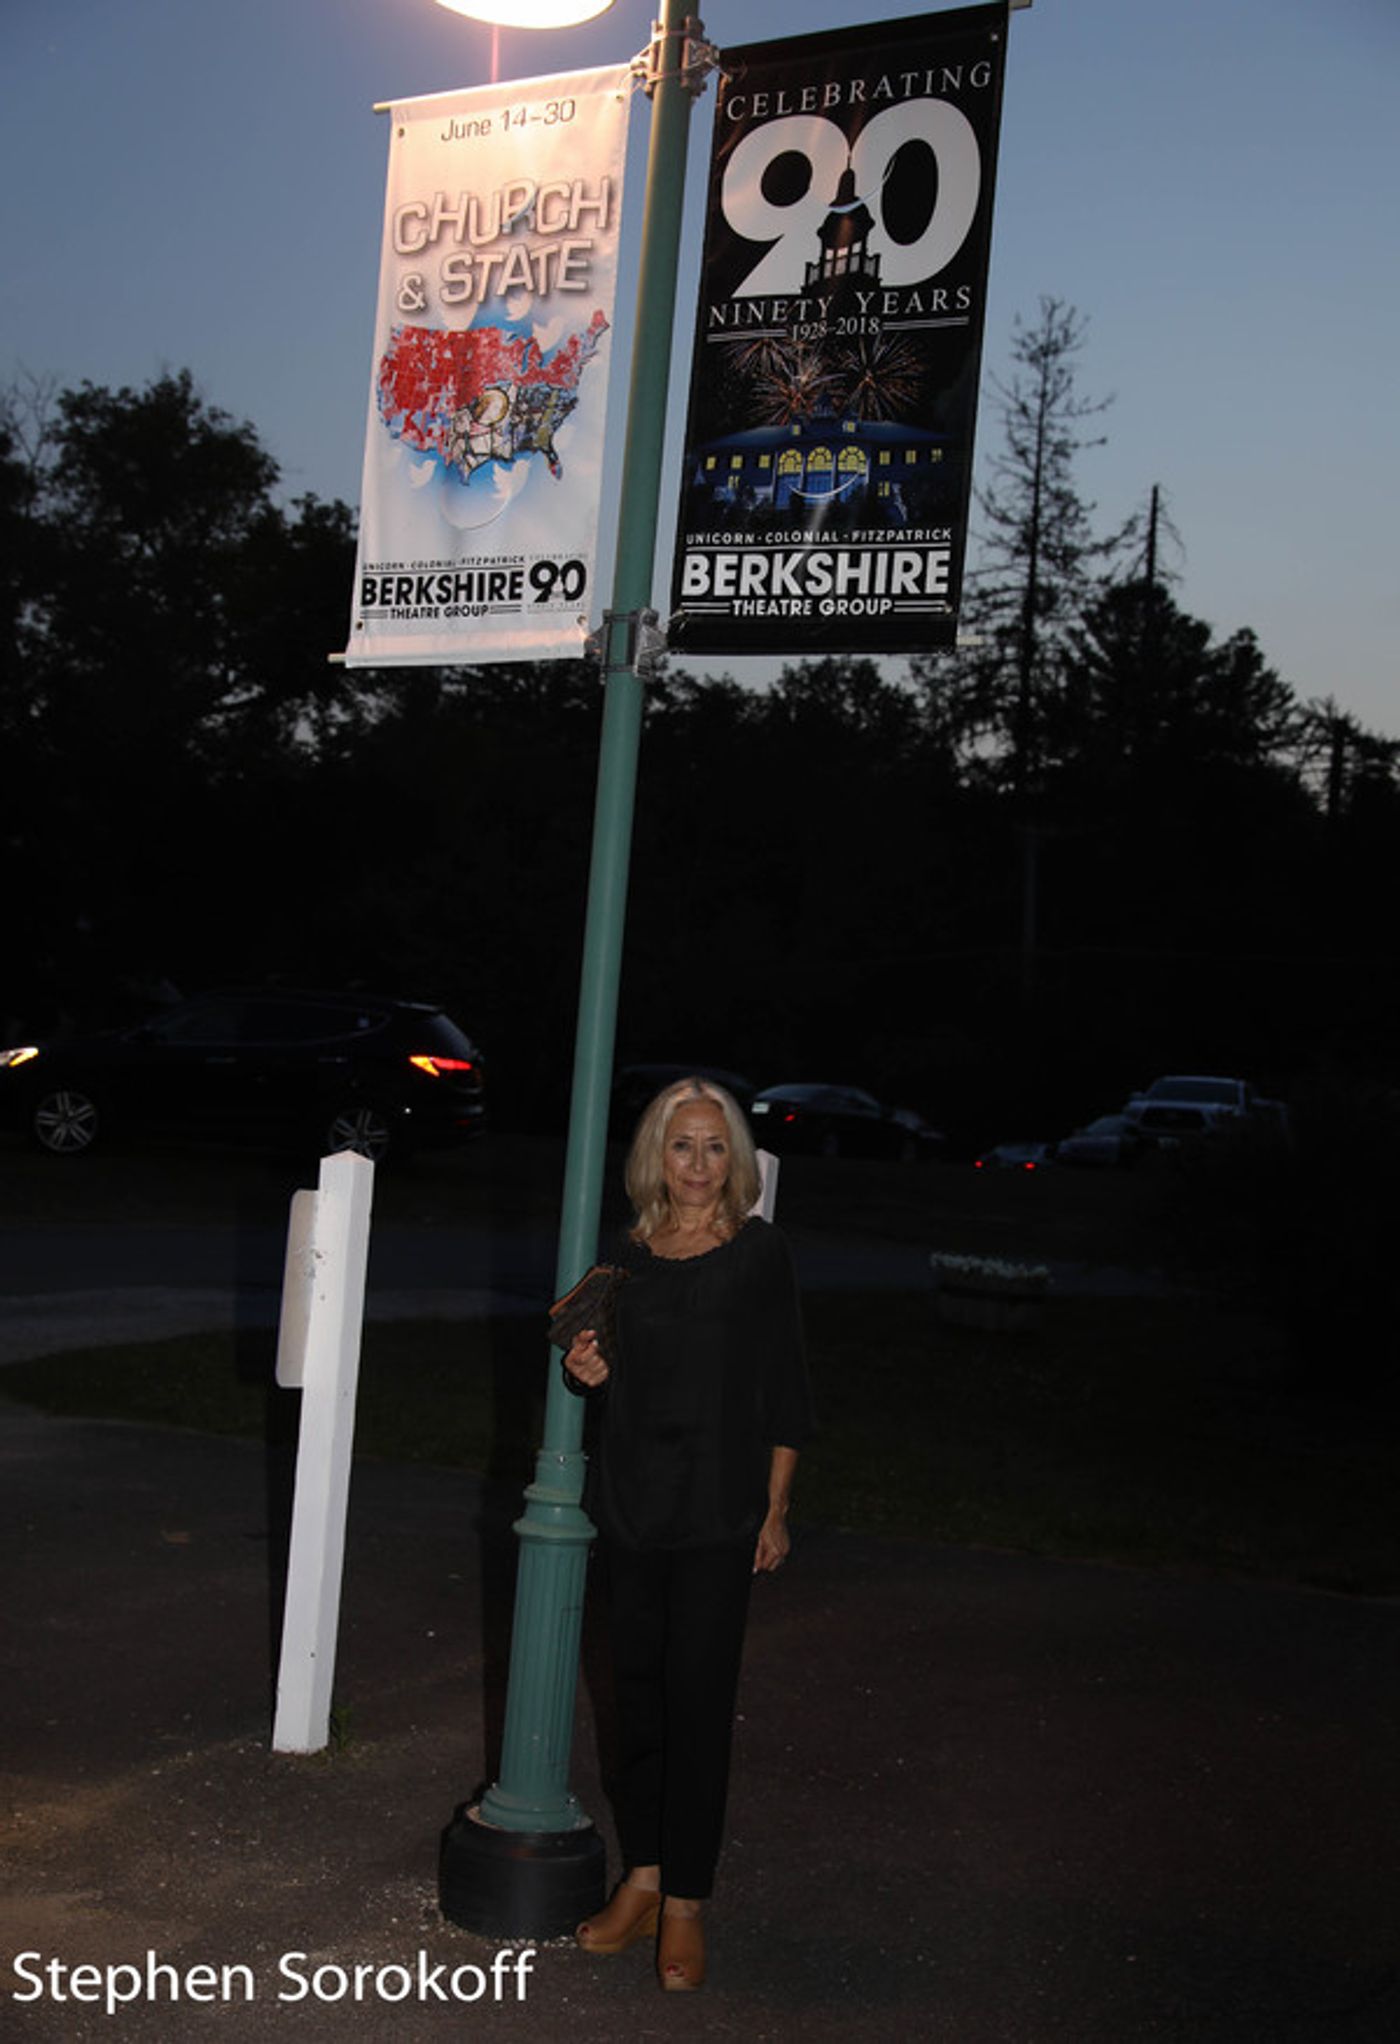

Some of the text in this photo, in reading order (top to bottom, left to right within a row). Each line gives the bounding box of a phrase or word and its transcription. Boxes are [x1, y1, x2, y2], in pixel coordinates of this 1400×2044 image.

[726, 61, 991, 121] CELEBRATING
[441, 119, 492, 141] June
[393, 177, 611, 254] CHURCH
[721, 97, 981, 298] 90
[398, 238, 593, 310] & STATE
[708, 286, 971, 327] NINETY YEARS
[686, 528, 951, 545] UNICORN COLONIAL FITZPATRICK
[361, 560, 586, 605] BERKSHIRE 90
[681, 551, 950, 596] BERKSHIRE
[390, 604, 488, 619] THEATRE GROUP
[732, 598, 893, 615] THEATRE GROUP
